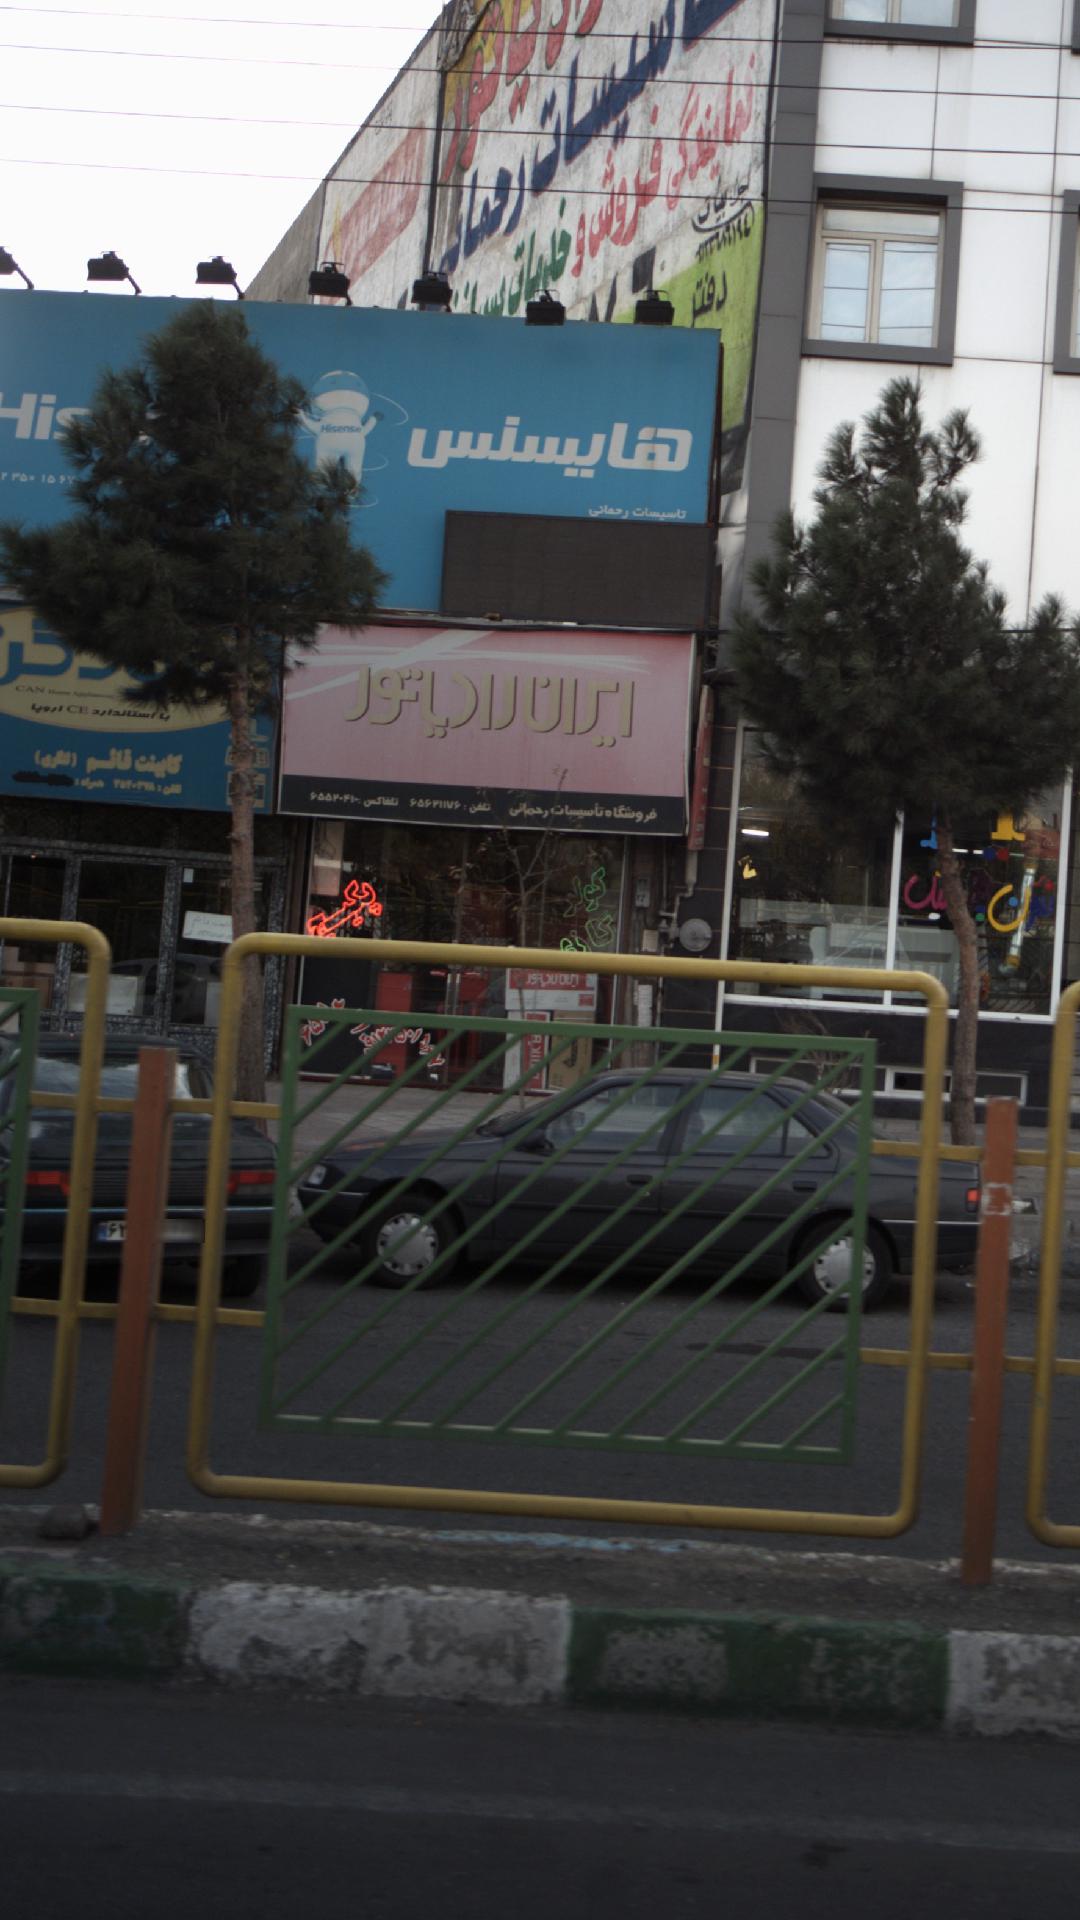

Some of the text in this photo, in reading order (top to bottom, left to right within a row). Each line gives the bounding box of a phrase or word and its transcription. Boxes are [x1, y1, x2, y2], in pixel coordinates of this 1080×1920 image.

[588, 103, 662, 259] فروش
[407, 416, 693, 478] هایسنس
[588, 505, 687, 520] تاسیسات رحمانی
[15, 685, 47, 695] CAN
[344, 664, 635, 747] ایران رادیاتور
[508, 802, 549, 819] رحمانی
[605, 804, 658, 823] فروشگاه
